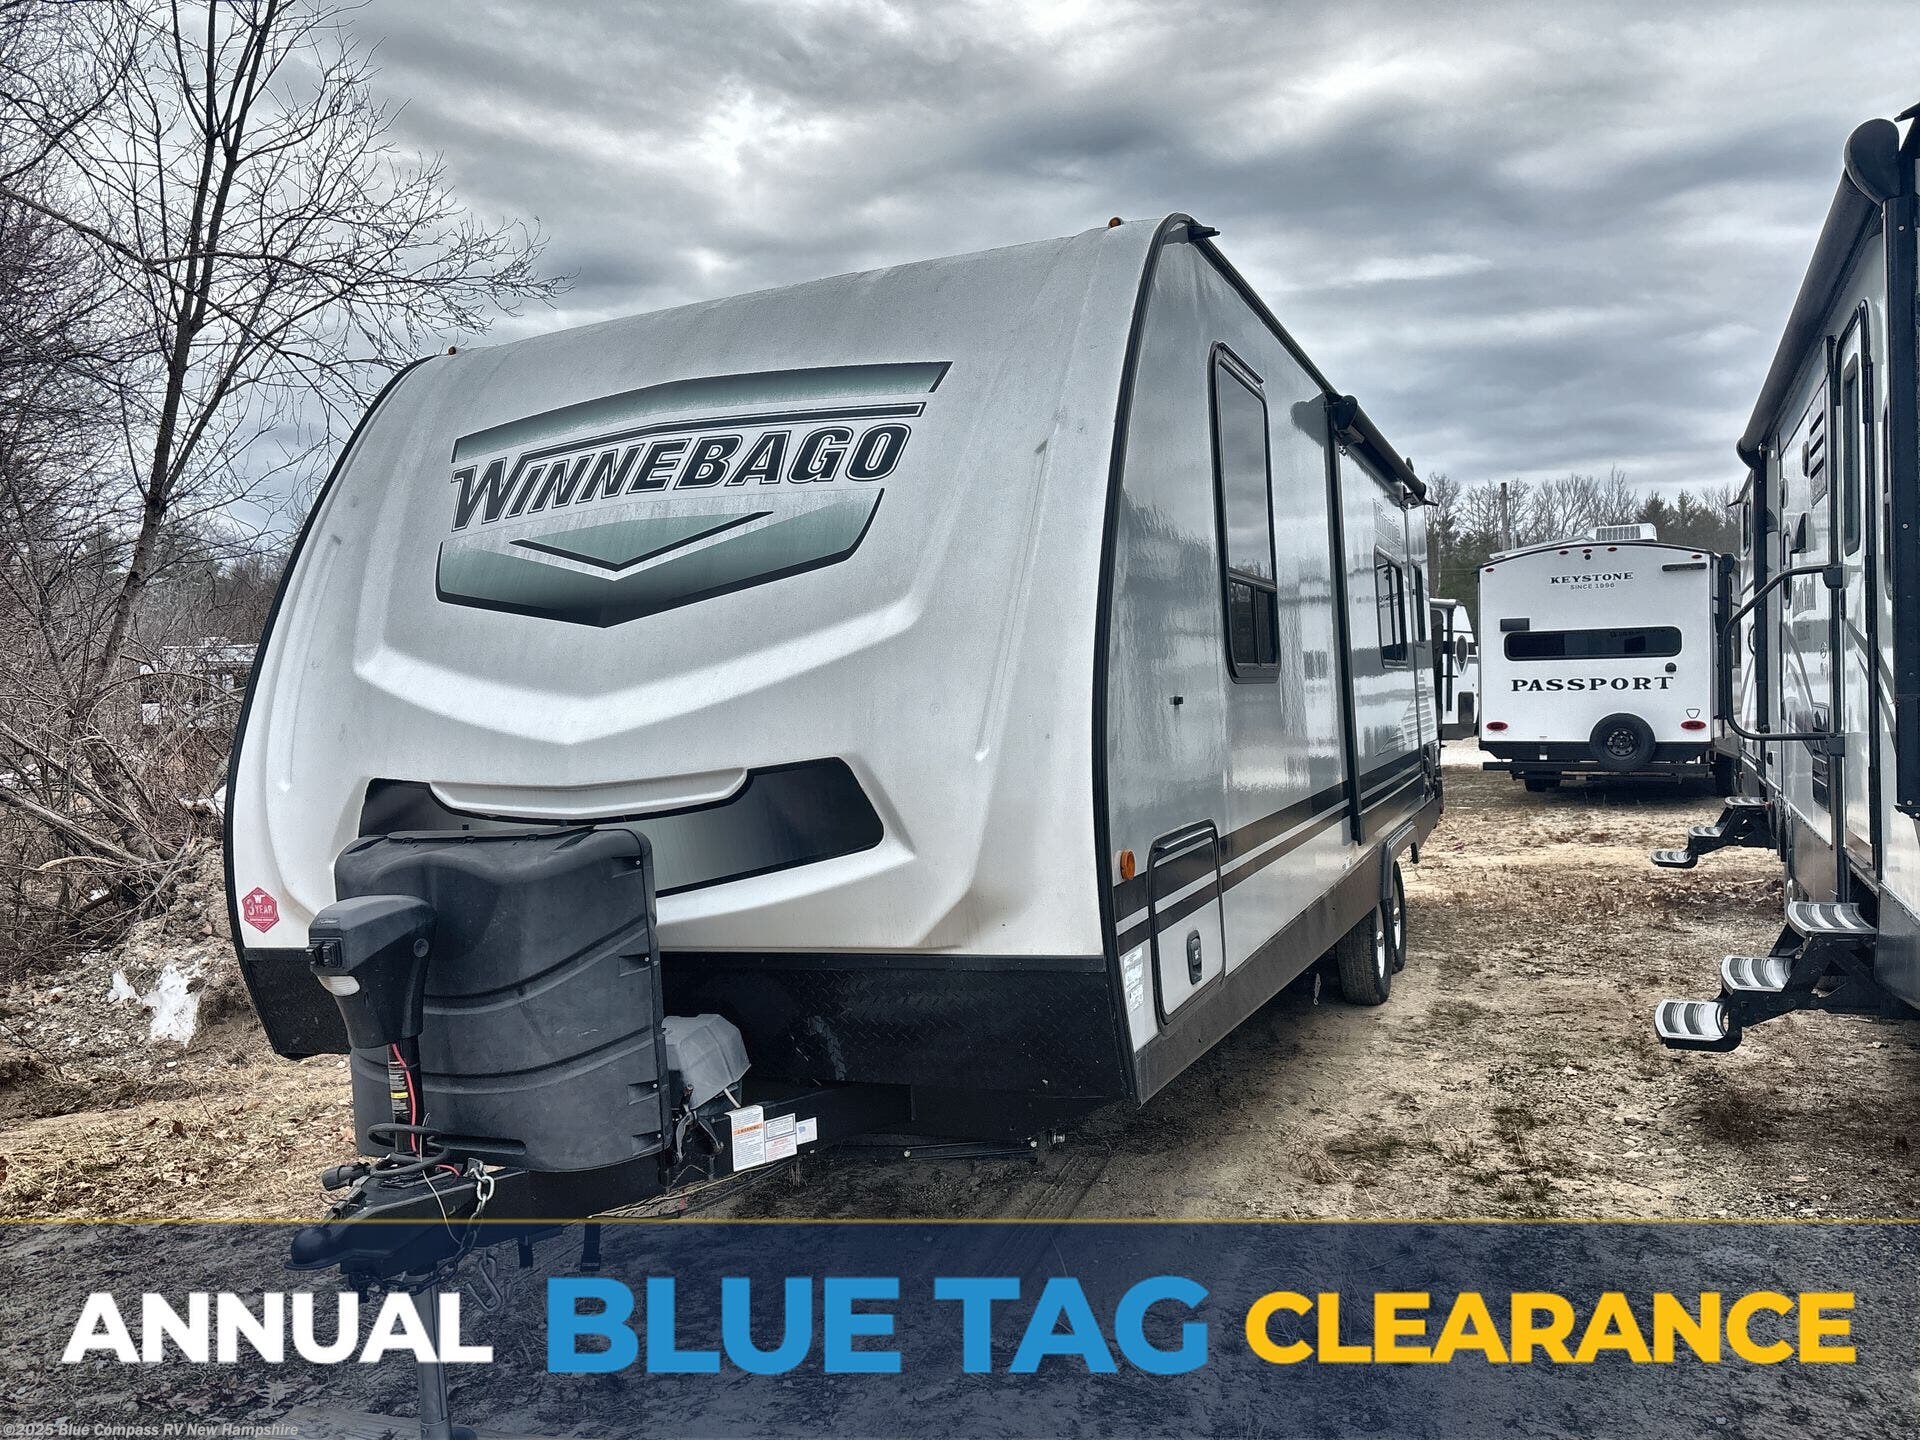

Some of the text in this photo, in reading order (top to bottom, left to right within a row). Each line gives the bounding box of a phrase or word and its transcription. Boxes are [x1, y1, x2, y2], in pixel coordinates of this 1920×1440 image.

[450, 422, 912, 532] WINNEBAGO
[1550, 572, 1634, 584] KEYSTONE
[1511, 676, 1674, 692] PASSPORT
[255, 905, 273, 914] YEAR
